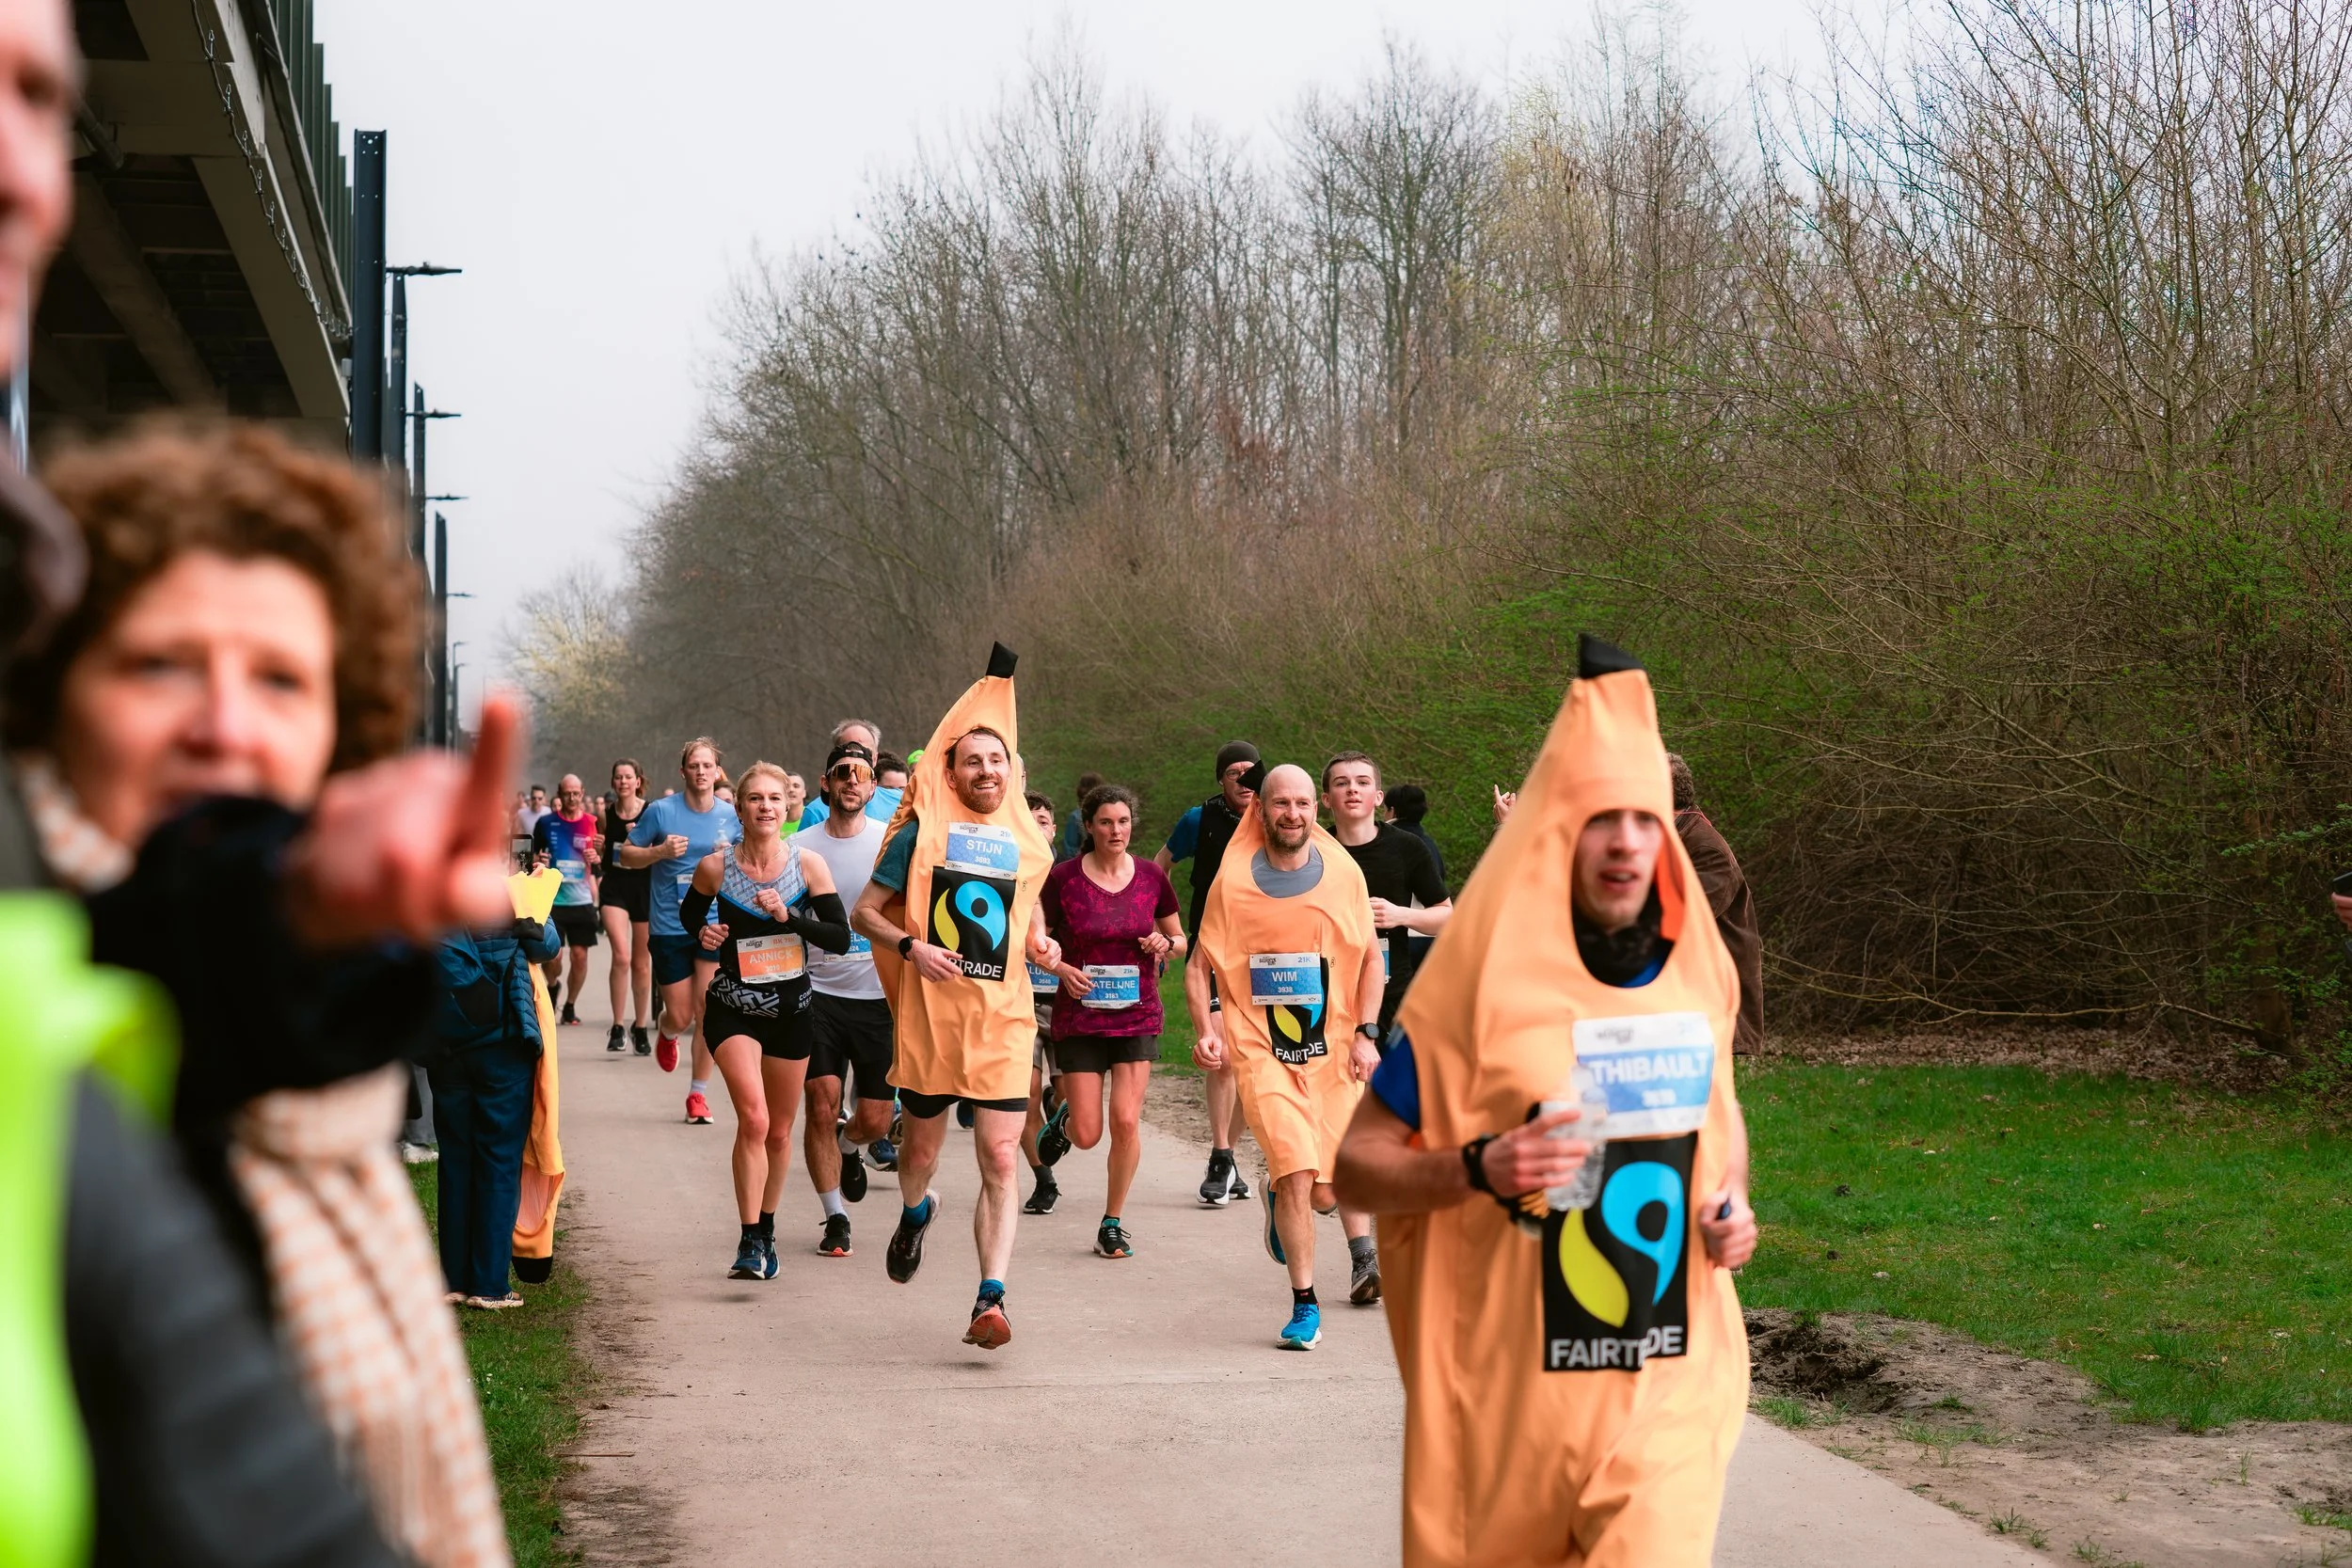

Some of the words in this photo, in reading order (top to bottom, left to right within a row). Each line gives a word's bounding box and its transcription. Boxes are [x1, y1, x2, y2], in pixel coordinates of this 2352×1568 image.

[966, 839, 1003, 855] STIJN
[750, 949, 793, 964] ANNICK
[1272, 971, 1297, 982] WIM
[1588, 1052, 1708, 1085] THIBAULT
